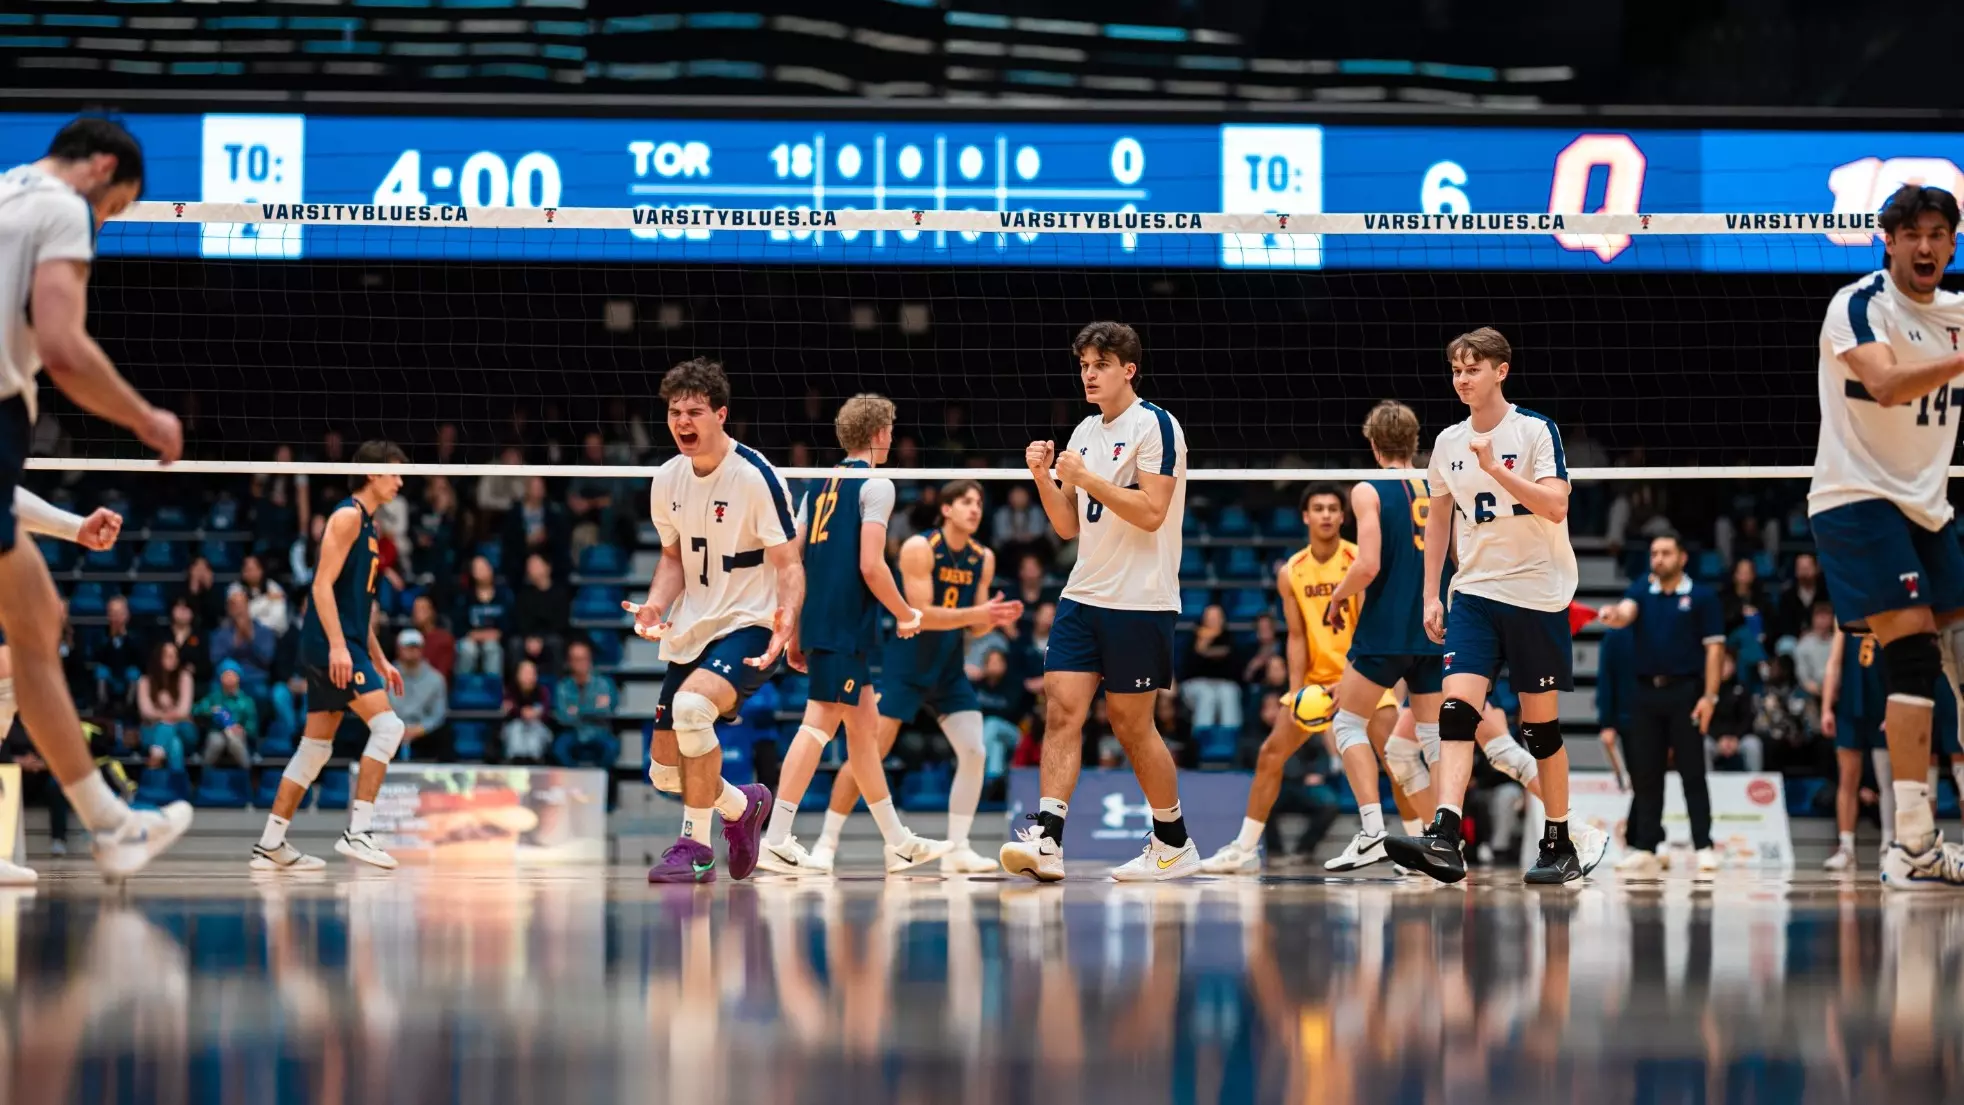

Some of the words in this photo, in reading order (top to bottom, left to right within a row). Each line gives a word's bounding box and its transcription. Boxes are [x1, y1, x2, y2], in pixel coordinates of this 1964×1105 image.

[224, 143, 283, 183] TO:
[373, 149, 562, 207] 4:00
[630, 141, 712, 177] TOR
[769, 143, 812, 178] 18
[1111, 136, 1145, 185] 0
[1245, 154, 1302, 191] TO:
[263, 203, 468, 221] VARSITYBLUES.CA
[633, 209, 837, 226] VARSITYBLUES.CA
[1000, 212, 1203, 229] VARSITYBLUES.CA
[1364, 214, 1566, 230] VARSITYBLUES.CA
[809, 491, 838, 544] 12
[1474, 492, 1497, 524] 6
[691, 537, 709, 587] 7
